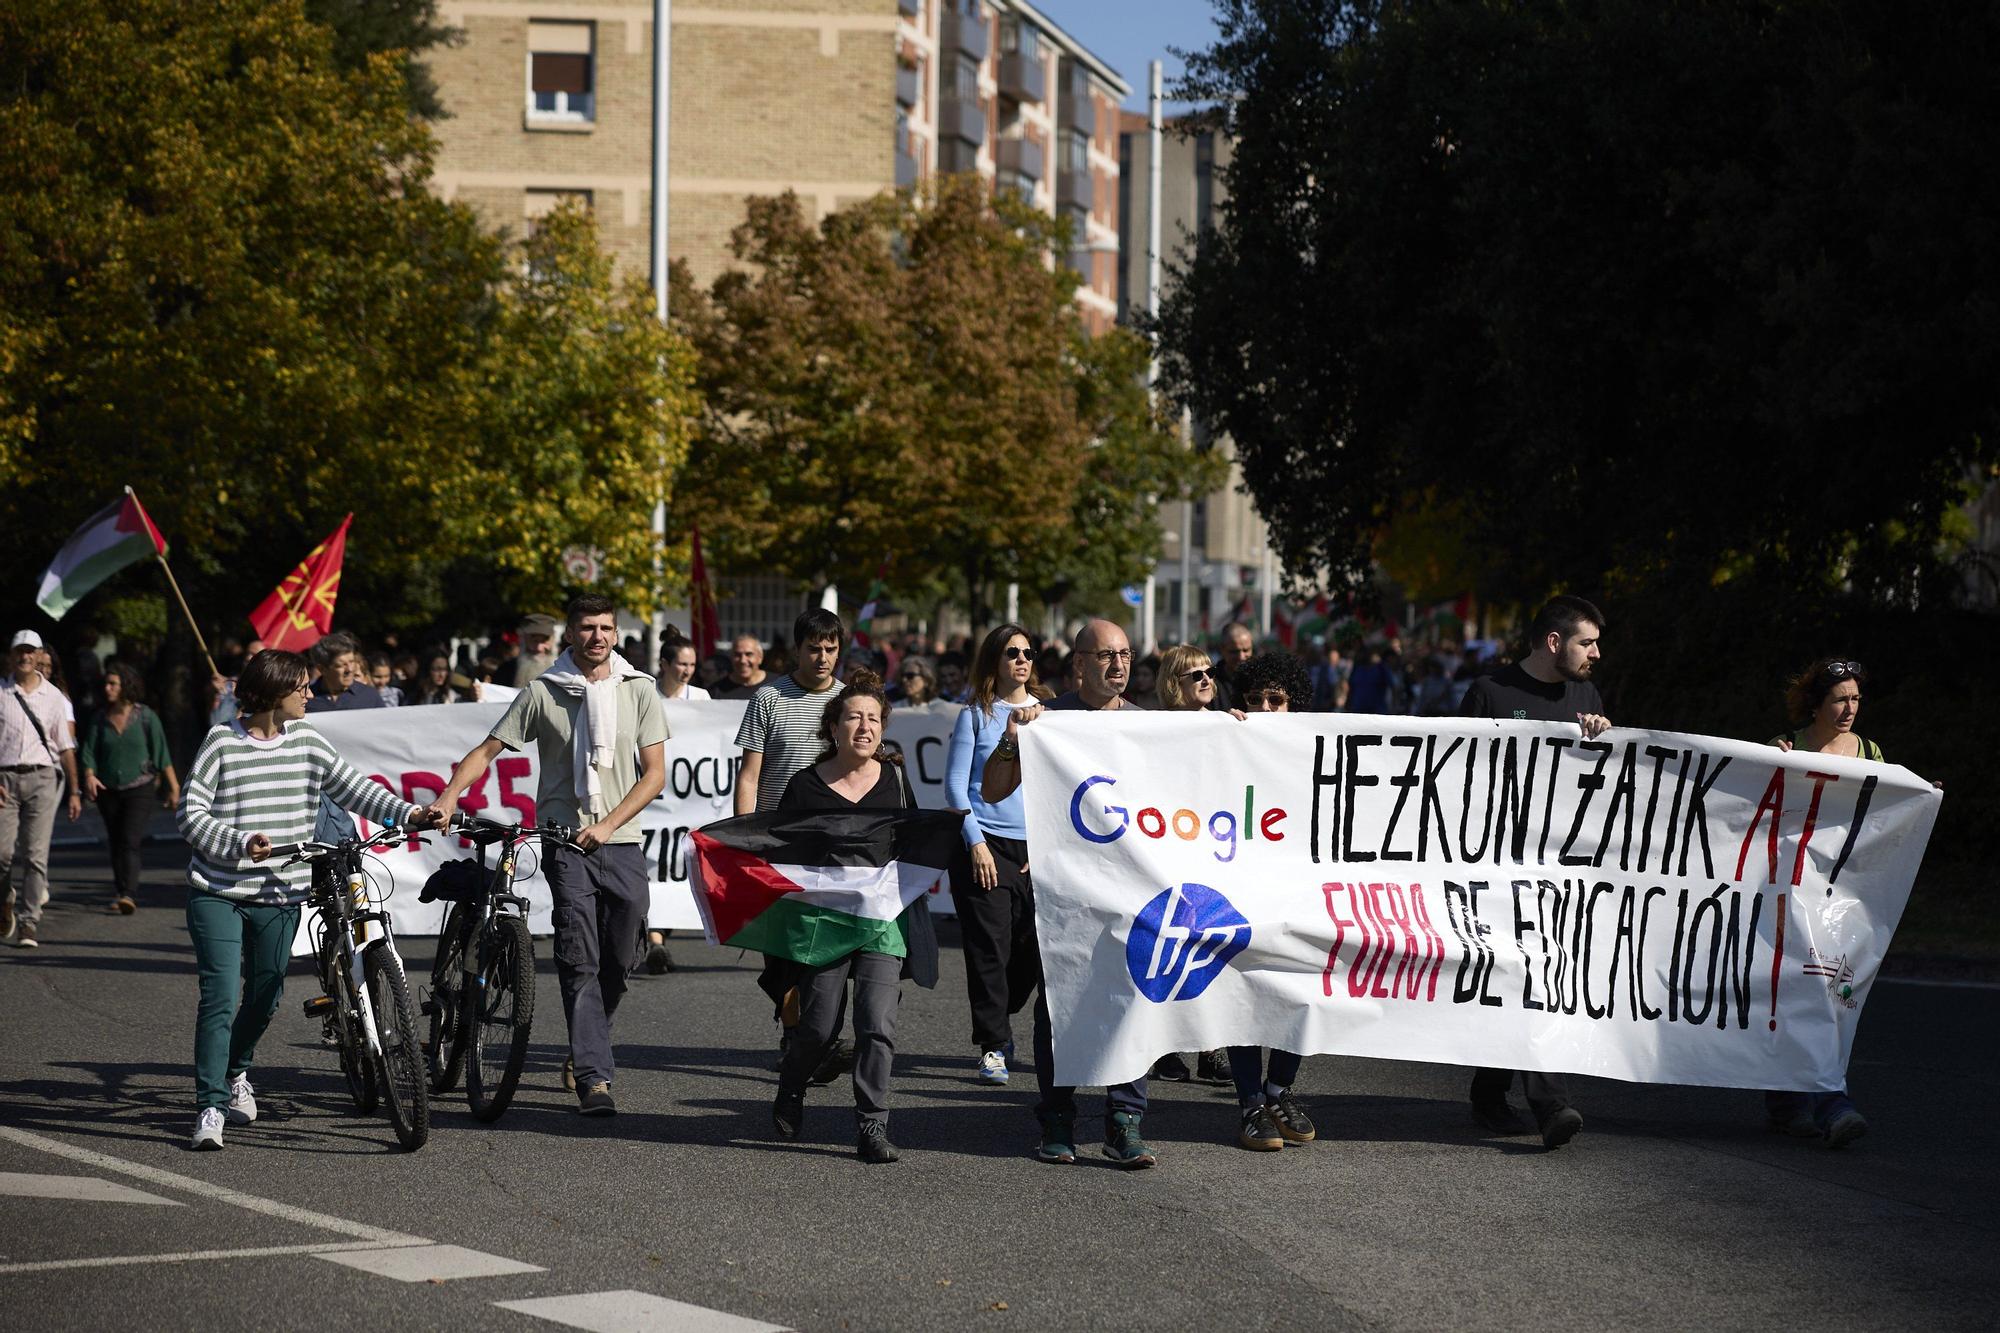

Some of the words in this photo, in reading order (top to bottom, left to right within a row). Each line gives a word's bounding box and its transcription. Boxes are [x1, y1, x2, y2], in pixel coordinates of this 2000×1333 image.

[1070, 775, 1287, 862] Google
[1310, 734, 1733, 880] HEZKUNTZATIK
[1140, 883, 1251, 1002] hp
[1322, 881, 1445, 1001] FUERA
[1444, 880, 1503, 1007] DE
